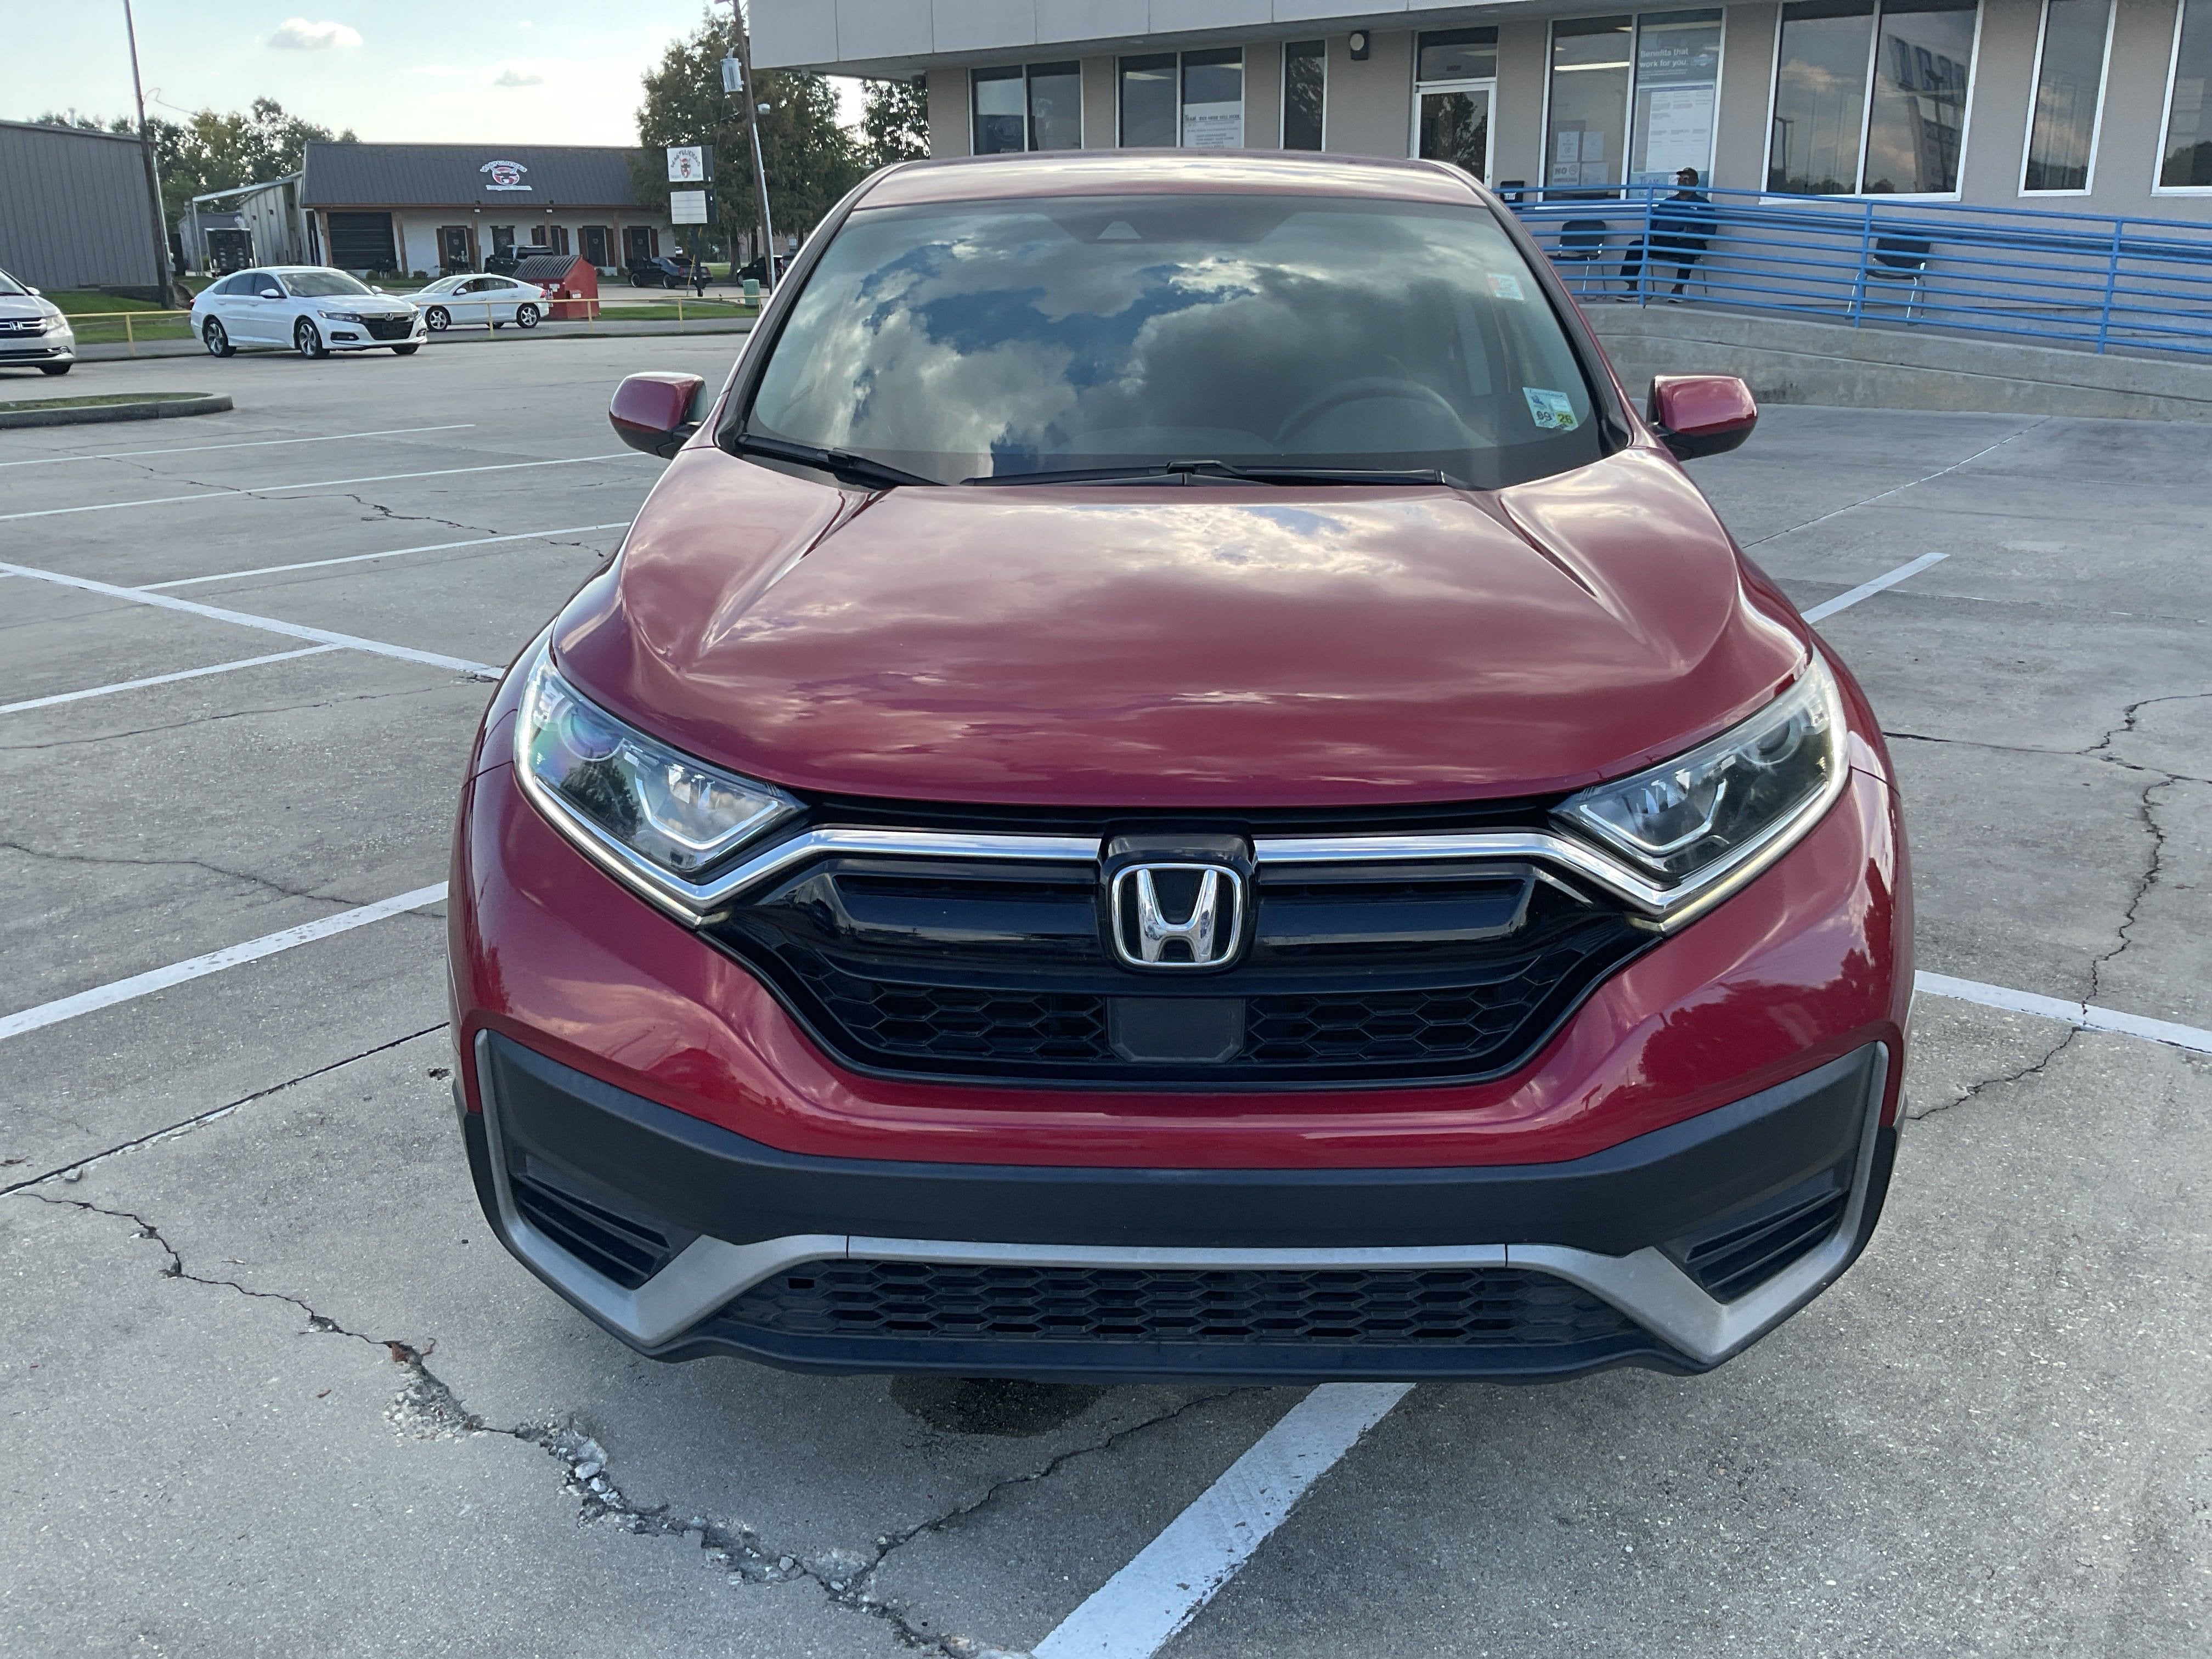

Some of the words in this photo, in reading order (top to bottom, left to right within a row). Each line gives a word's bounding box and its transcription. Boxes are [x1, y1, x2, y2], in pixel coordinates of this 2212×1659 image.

[1640, 48, 1672, 58] Benefits
[1555, 167, 1567, 175] NO
[1558, 414, 1573, 424] 26
